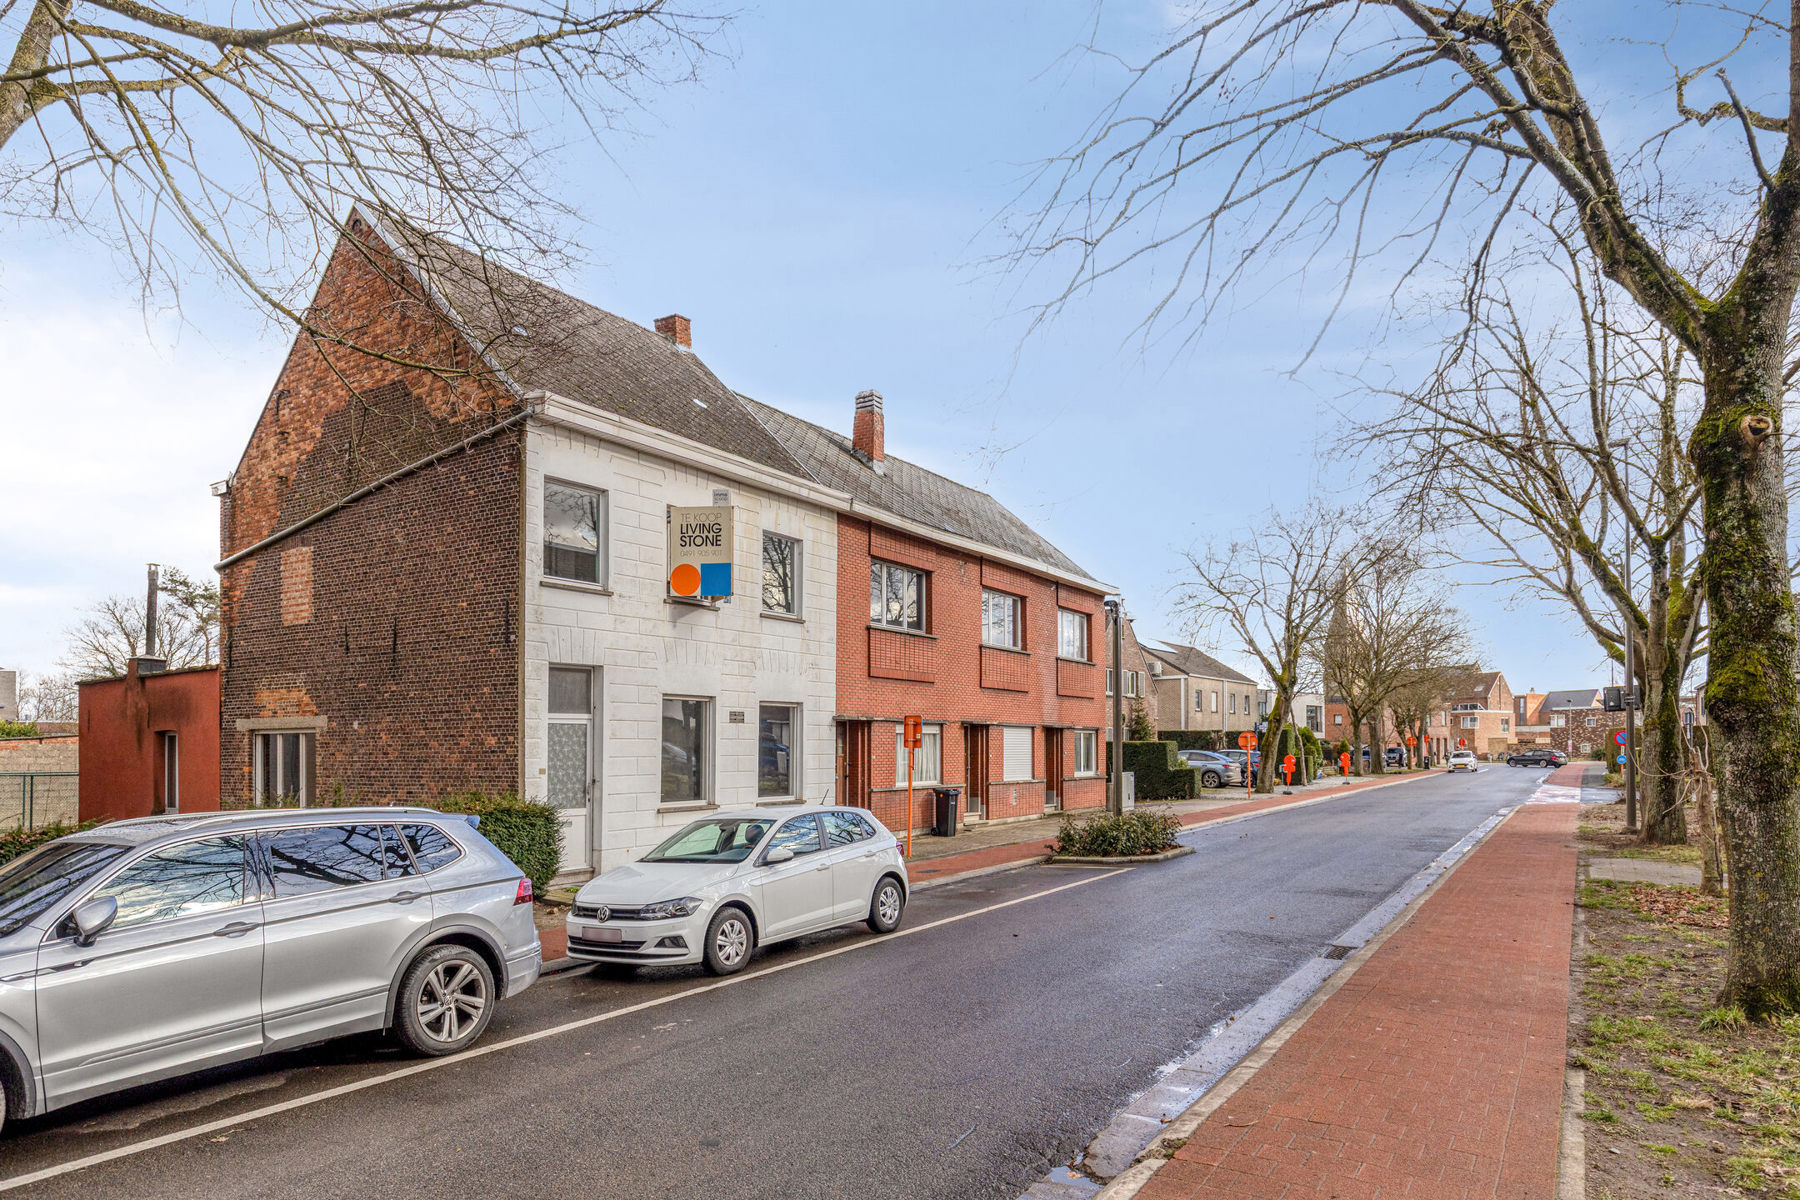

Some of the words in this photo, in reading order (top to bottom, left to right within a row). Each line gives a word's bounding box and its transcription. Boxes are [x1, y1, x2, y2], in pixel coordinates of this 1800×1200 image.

[681, 513, 690, 522] TE
[694, 512, 722, 522] KOOP
[680, 523, 722, 534] LIVING
[680, 535, 722, 547] STONE
